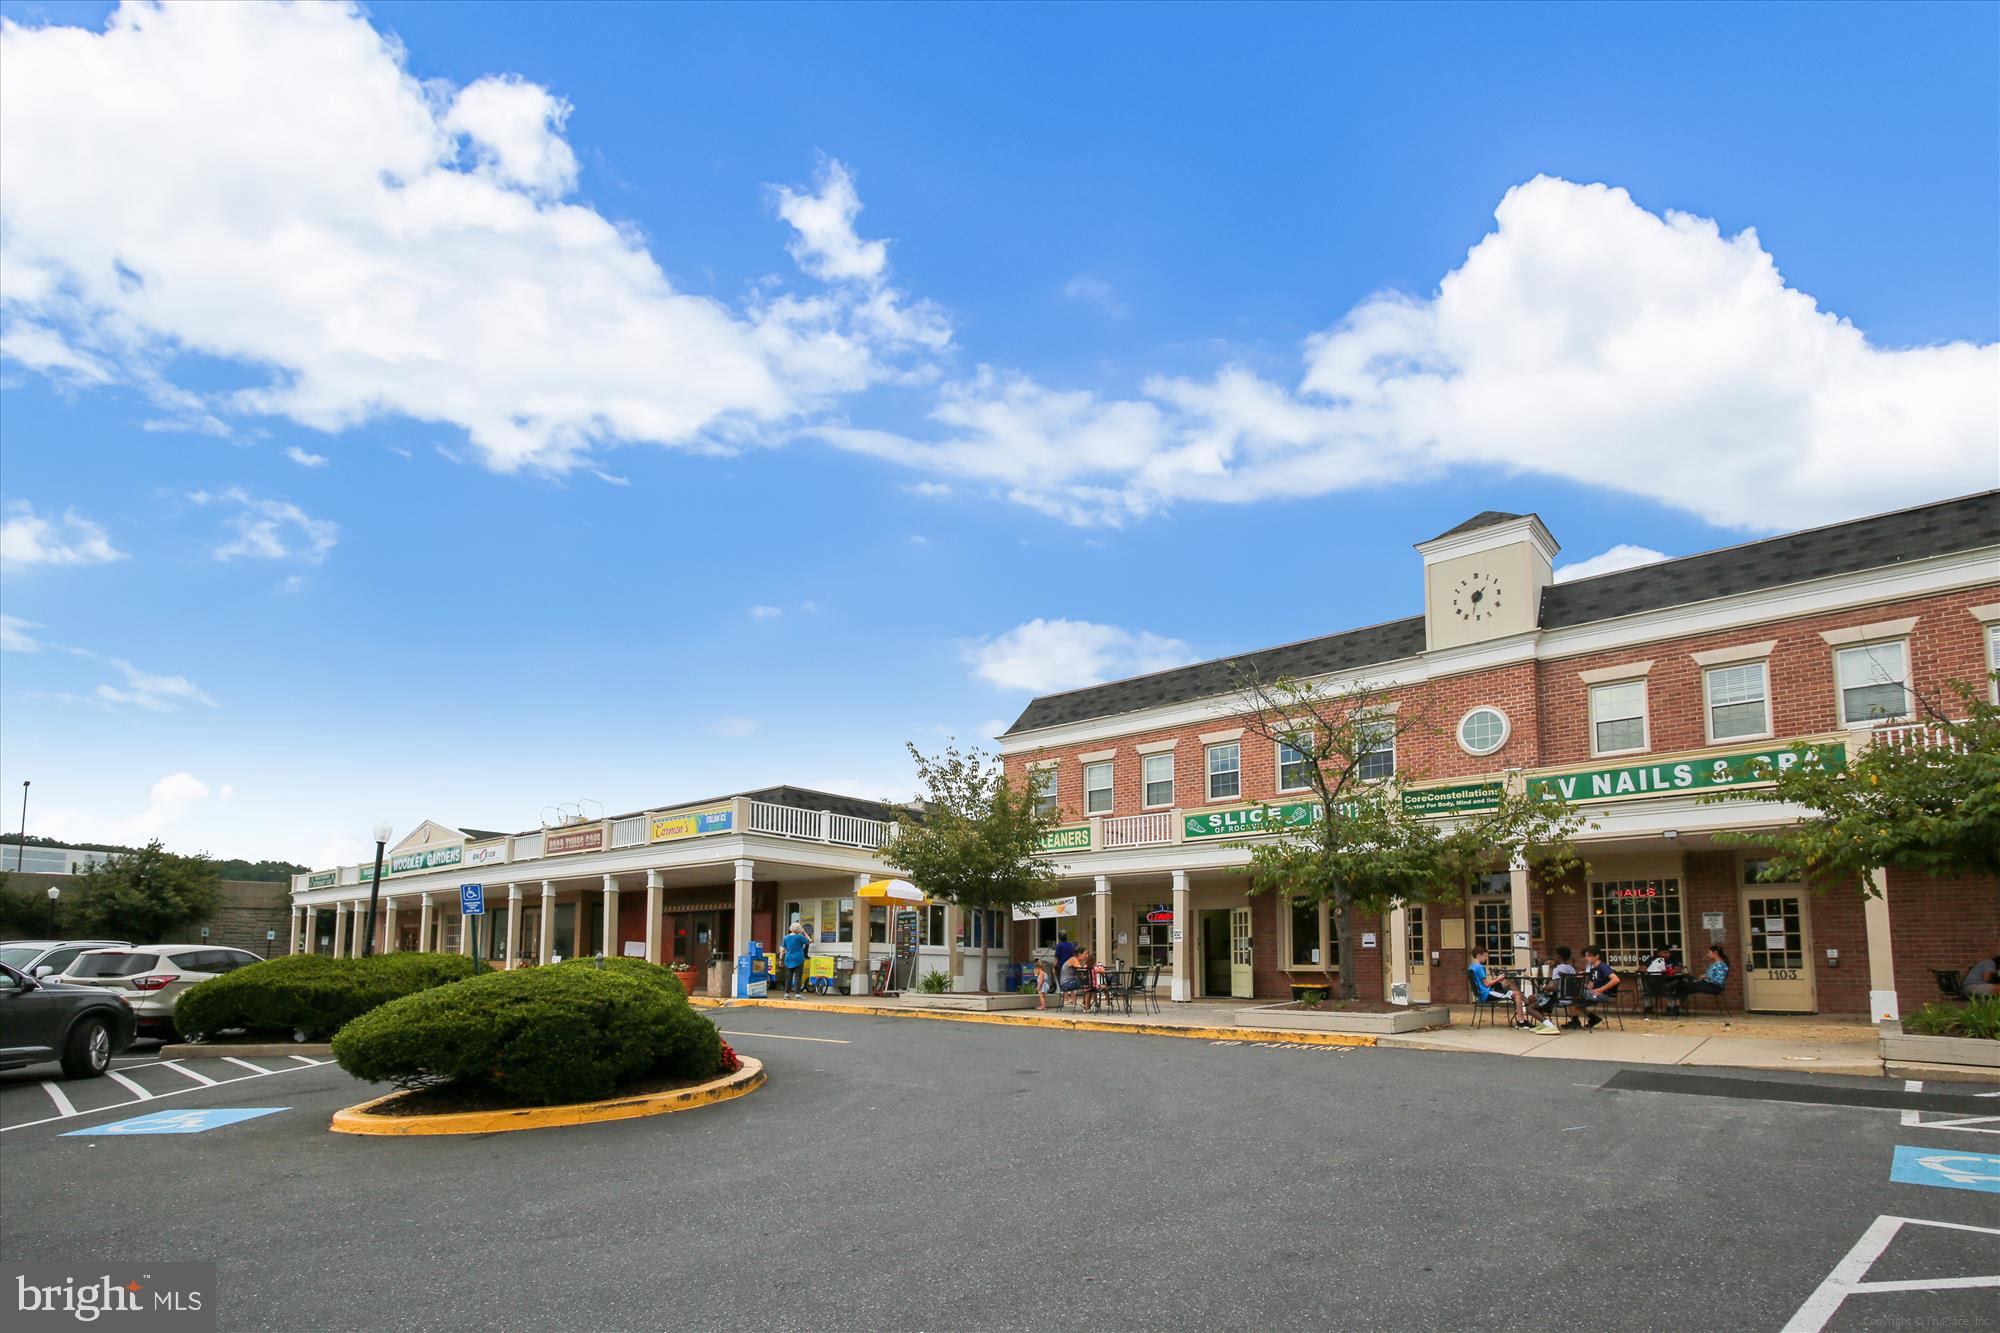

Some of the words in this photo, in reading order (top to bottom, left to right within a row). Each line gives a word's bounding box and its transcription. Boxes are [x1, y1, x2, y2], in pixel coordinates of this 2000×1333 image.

[1541, 777, 1576, 800] LV
[1592, 764, 1693, 796] NAILS
[1711, 760, 1734, 784] &
[1208, 807, 1282, 827] SLICE
[656, 820, 689, 838] Carmen's
[1214, 826, 1225, 834] OF
[1040, 829, 1089, 849] LEANERS
[393, 854, 425, 872] WOODLEY
[427, 848, 460, 867] GARDENS
[1612, 887, 1657, 897] NAILS
[1767, 969, 1797, 980] 1103
[1250, 1041, 1355, 1052] PARKING
